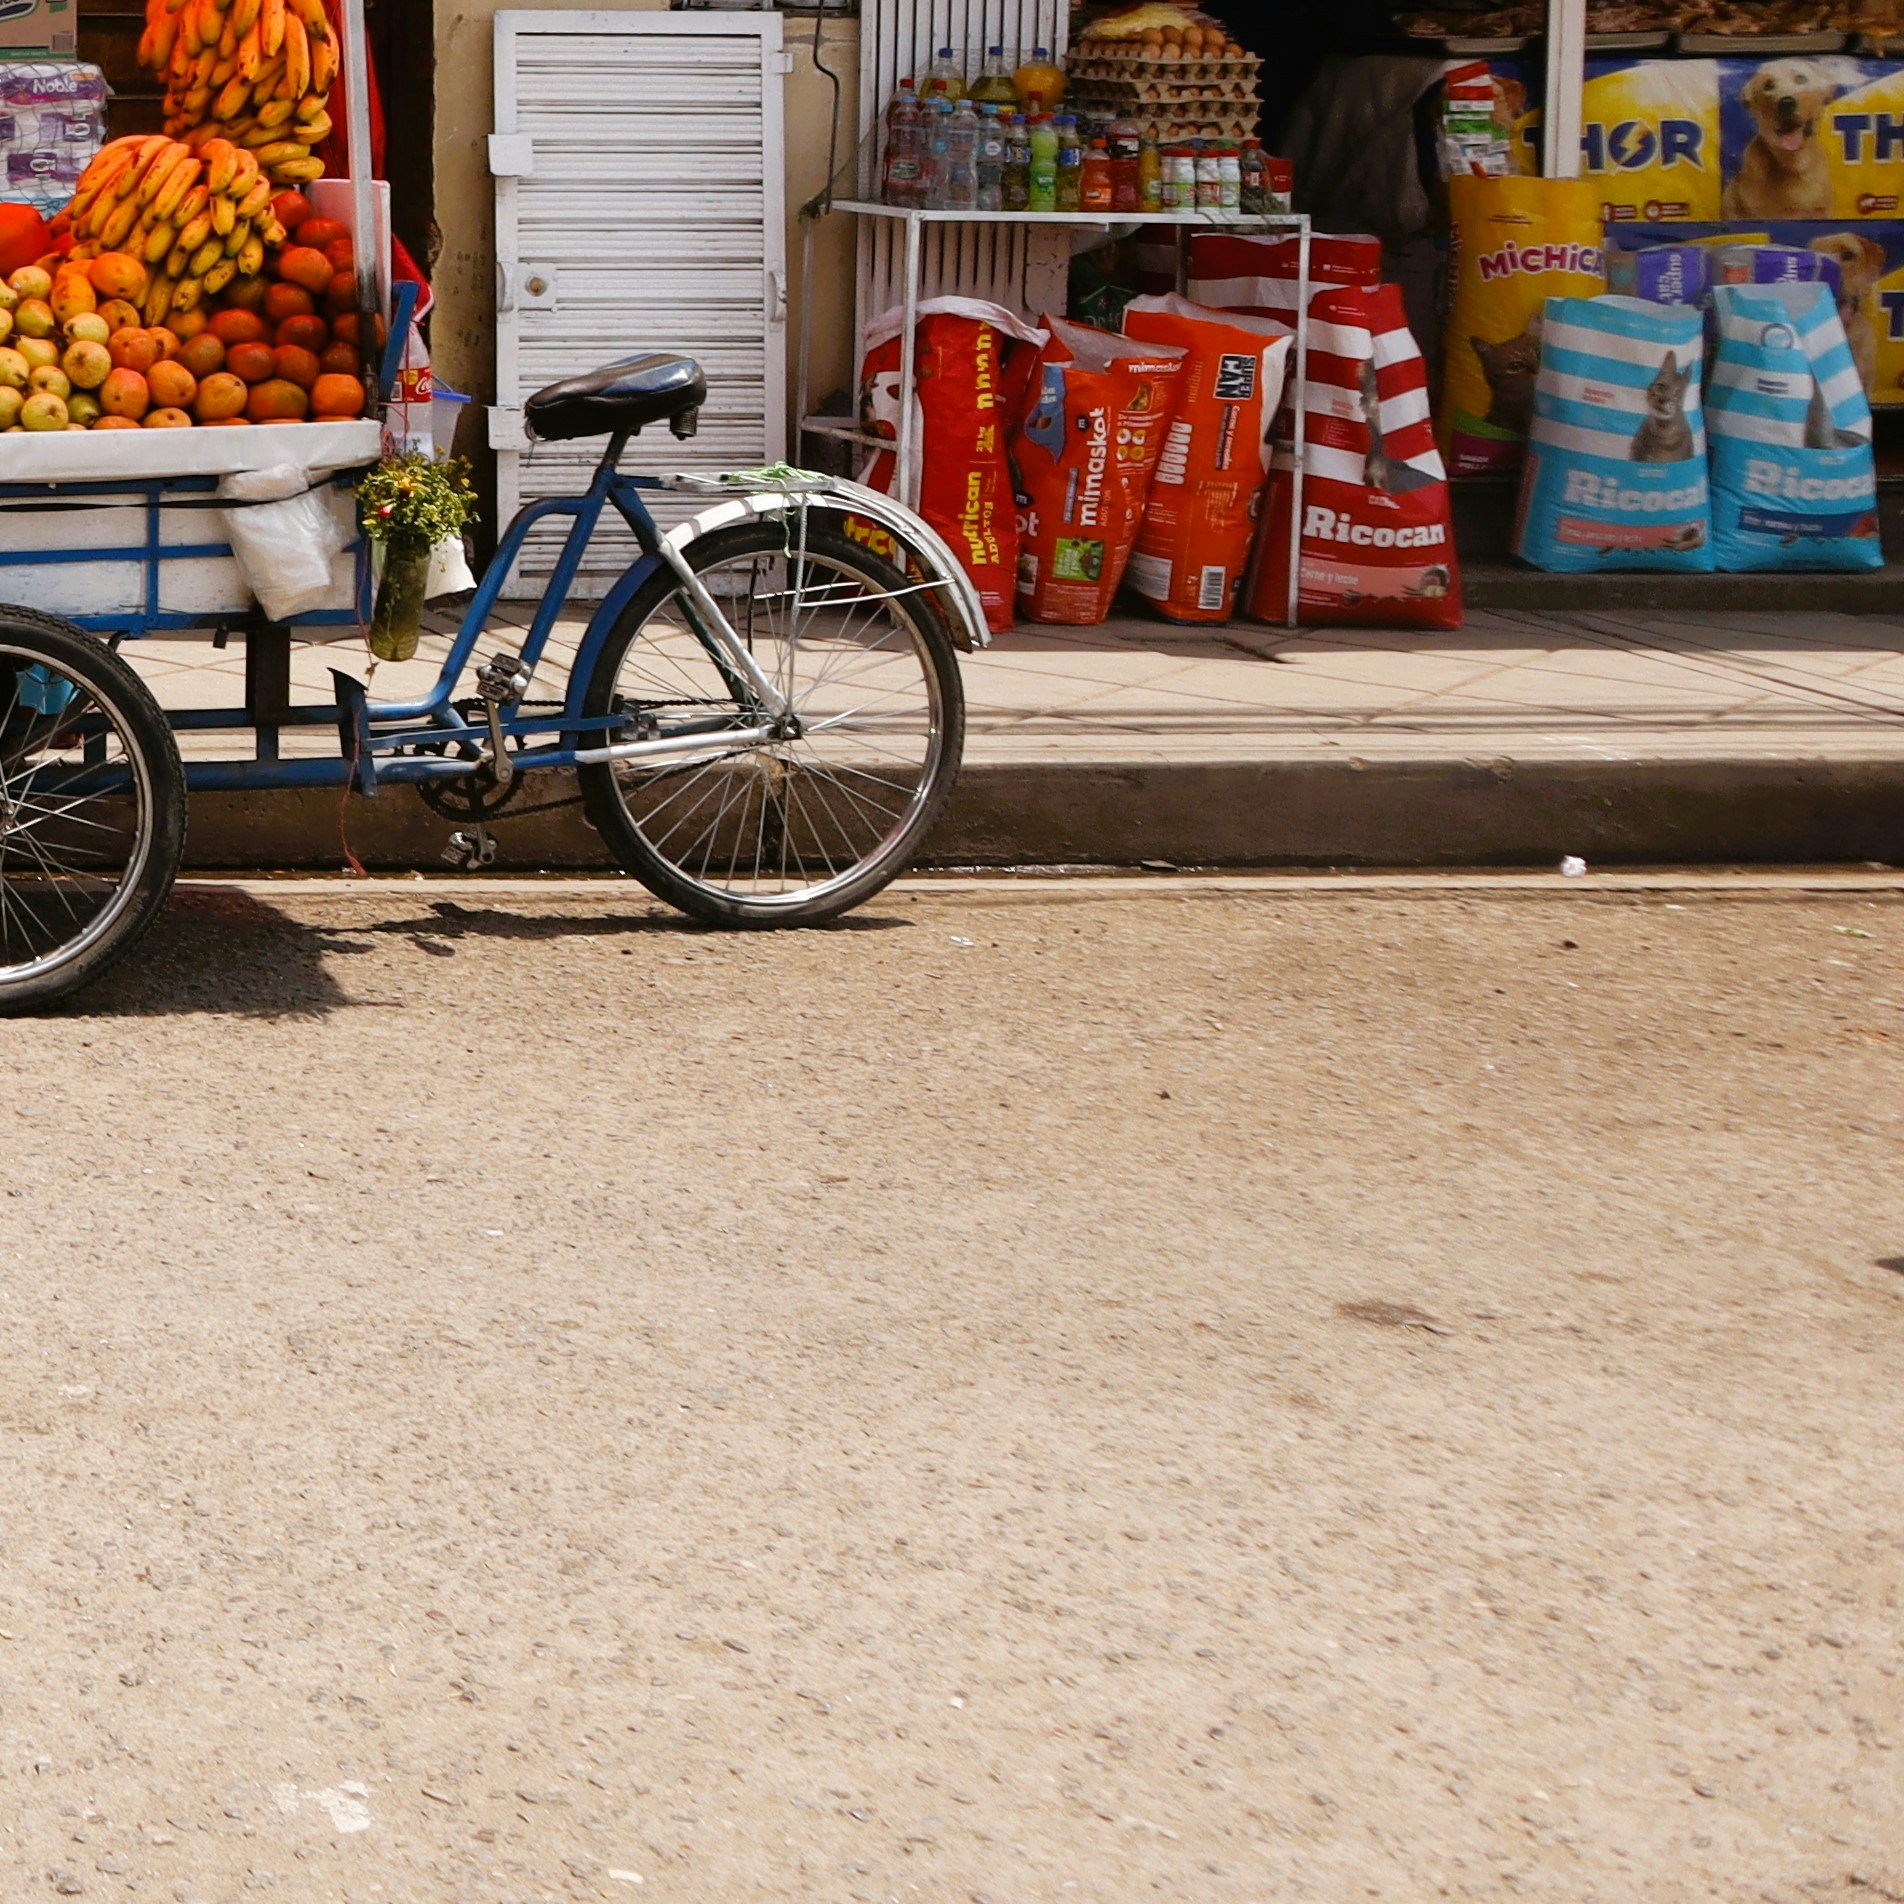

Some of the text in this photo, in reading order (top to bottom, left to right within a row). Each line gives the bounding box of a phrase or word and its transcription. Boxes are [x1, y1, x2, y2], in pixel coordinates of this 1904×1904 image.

[33, 78, 78, 93] Noble
[1216, 358, 1241, 397] CAN
[1078, 407, 1107, 527] mimaskot
[962, 471, 987, 566] nutrican
[1302, 505, 1446, 548] Ricocan
